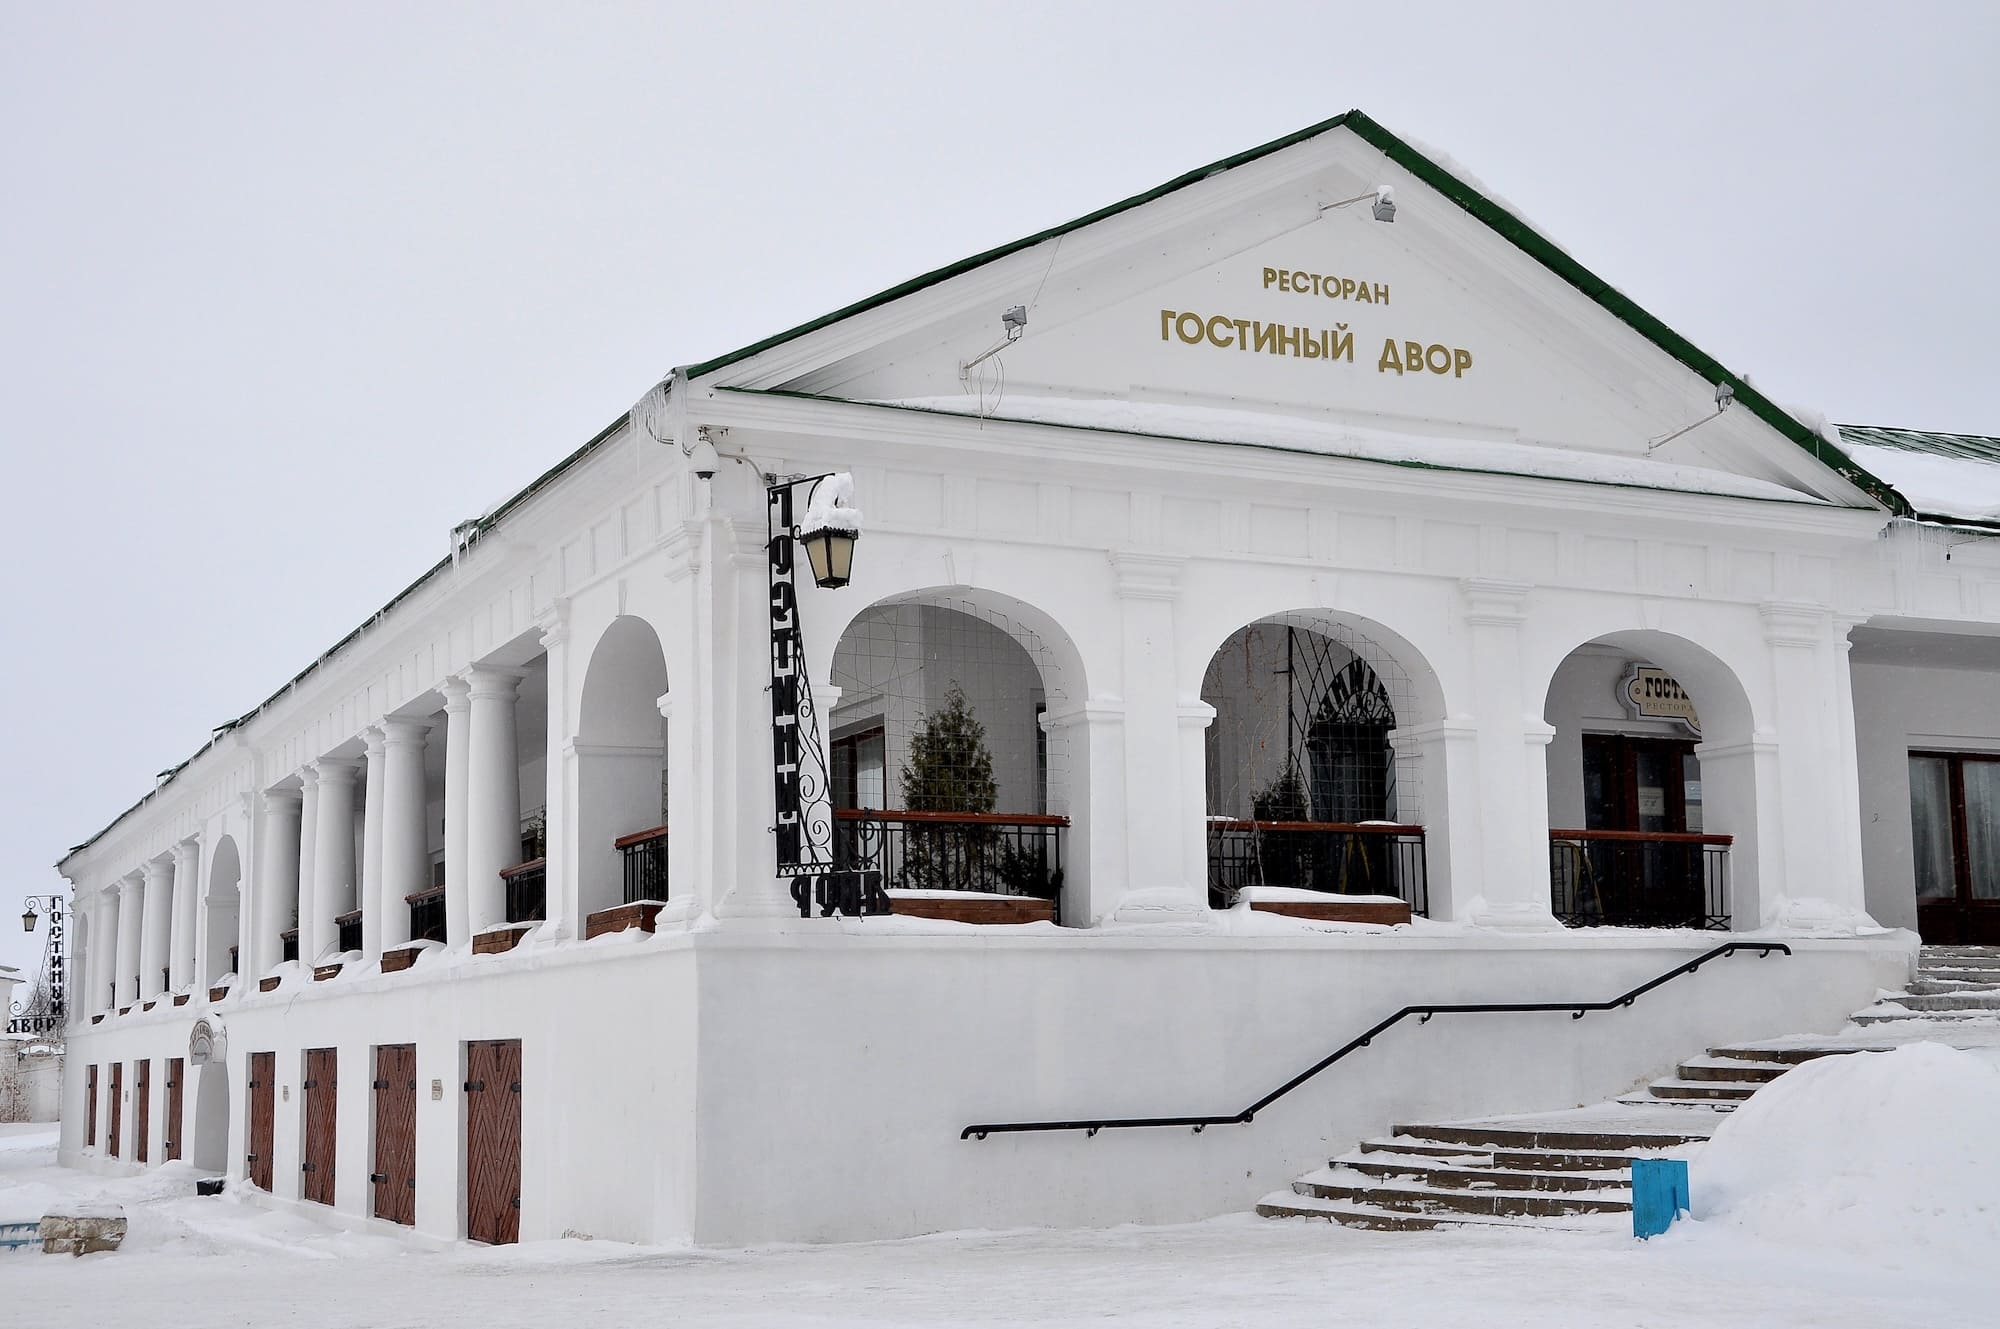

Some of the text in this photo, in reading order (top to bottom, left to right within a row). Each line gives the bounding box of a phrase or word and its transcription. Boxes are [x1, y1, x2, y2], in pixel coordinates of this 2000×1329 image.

[1263, 267, 1390, 305] РЕСТОРАН
[1161, 309, 1473, 378] ГОСТИНЫЙ ДВОР
[6, 1019, 56, 1034] ДВОР
